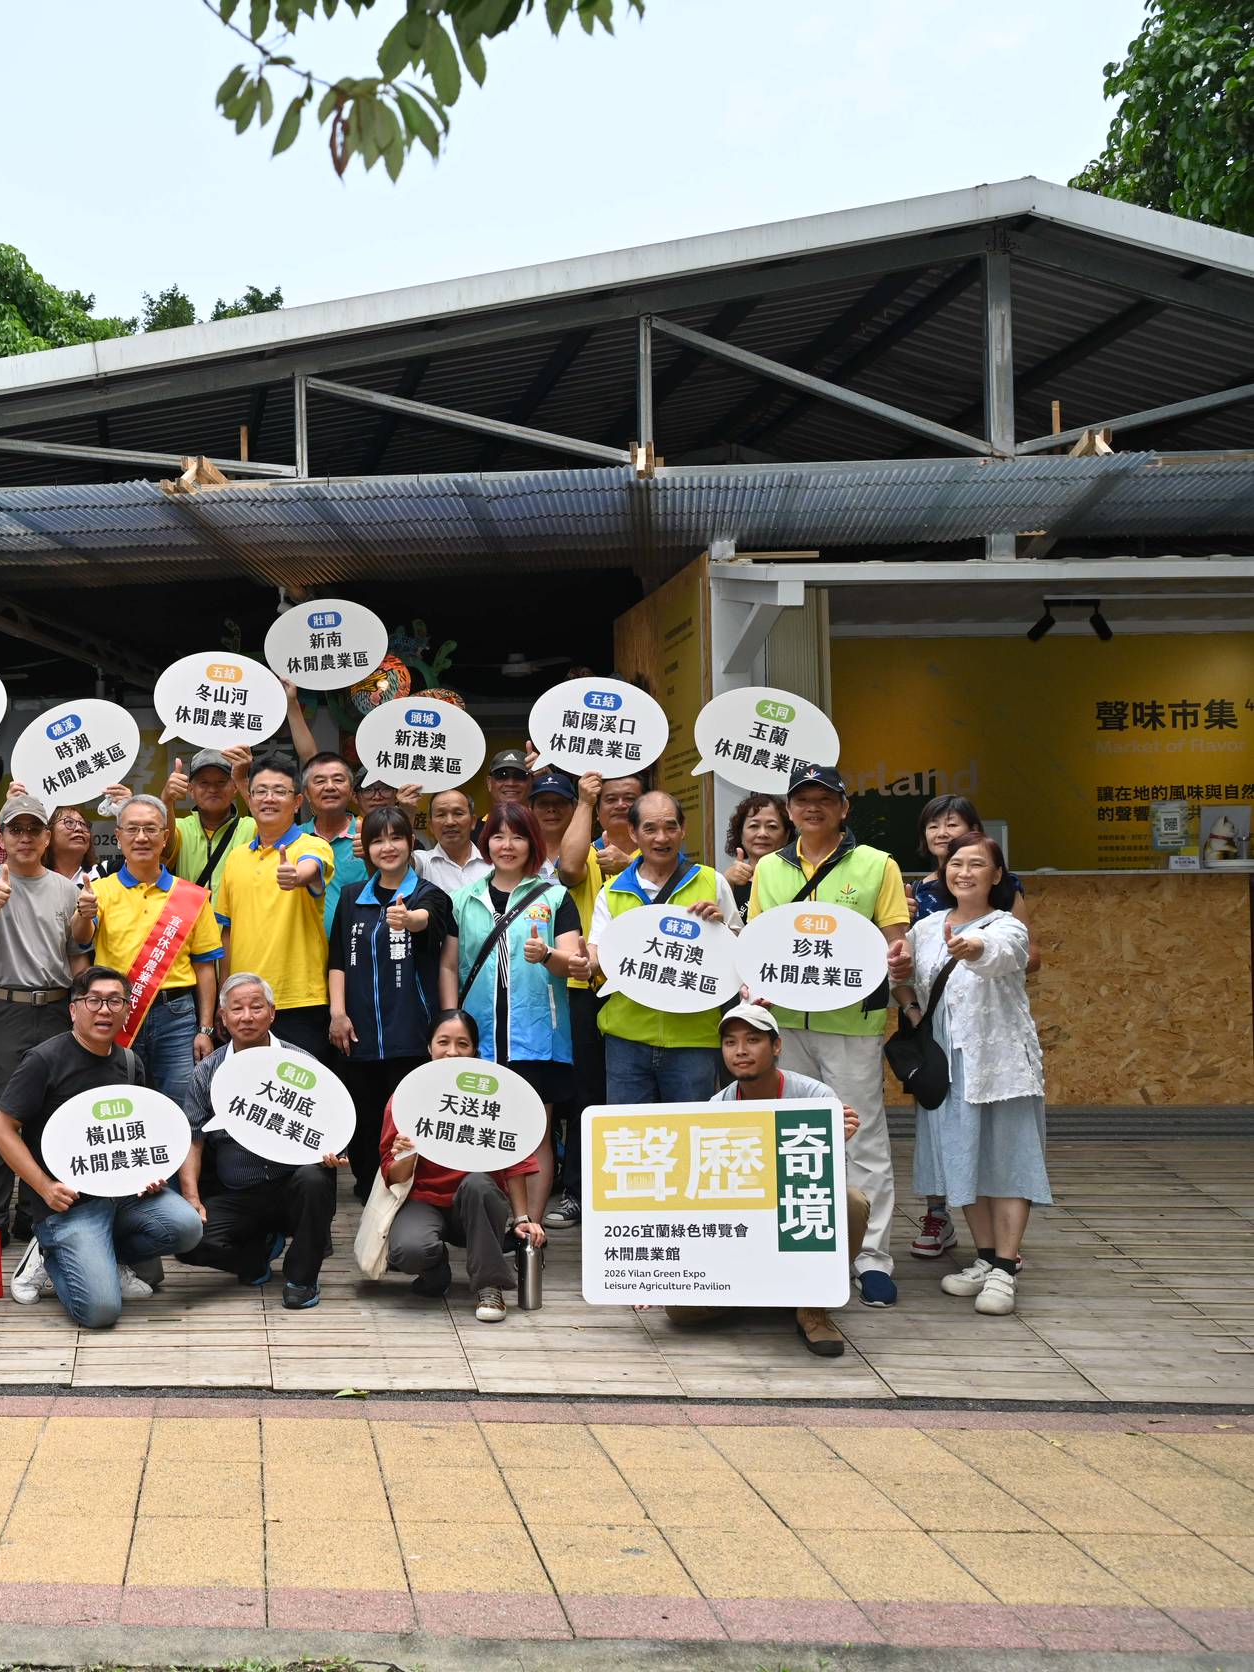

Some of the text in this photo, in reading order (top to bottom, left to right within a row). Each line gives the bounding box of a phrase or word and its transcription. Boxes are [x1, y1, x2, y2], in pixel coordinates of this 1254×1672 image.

[310, 632, 341, 649] 新南
[287, 652, 369, 673] 休閒農業區
[212, 666, 237, 681] 五結
[196, 684, 248, 705] 冬山河
[590, 694, 615, 707] 五結
[176, 706, 263, 731] 休閒農業區
[410, 712, 437, 726] 頭城
[563, 710, 635, 735] 蘭陽溪口
[761, 703, 790, 721] 大同
[1096, 699, 1238, 731] 聲味市集
[50, 717, 77, 737] 礁溪
[749, 722, 789, 746] 玉蘭
[55, 735, 91, 760] 時潮
[395, 729, 445, 750] 新港澳
[550, 734, 642, 760] 休閒農業區
[1097, 739, 1162, 753] Market
[1166, 738, 1187, 753] of
[43, 743, 126, 795] 休閒農業區
[376, 752, 461, 774] 休閒農業區
[1097, 784, 1254, 801] 讓在地的風味與自然
[664, 919, 693, 937] 蘇澳
[801, 916, 829, 932] 冬山
[643, 938, 703, 965] 大南澳
[793, 938, 833, 958] 珍珠
[123, 915, 182, 1032] 宜蘭休閒農業區代
[619, 957, 718, 994] 休閒農業區
[760, 963, 863, 987] 休閒農業區
[280, 1065, 313, 1089] 員山
[462, 1074, 494, 1092] 三星
[99, 1101, 126, 1118] 員山
[256, 1081, 316, 1117] 大湖底
[439, 1094, 500, 1121] 天送埤
[86, 1121, 146, 1146] 橫山頭
[229, 1096, 324, 1150] 休閒農業區
[415, 1117, 517, 1151] 休閒農業區
[70, 1145, 169, 1176] 休閒農業區
[778, 1123, 834, 1240] 奇境
[605, 1223, 748, 1238] 2026宜蘭綠色博覽會
[605, 1247, 679, 1261] 休閒農業館
[683, 1270, 705, 1279] Expo
[639, 1282, 691, 1291] Agriculture
